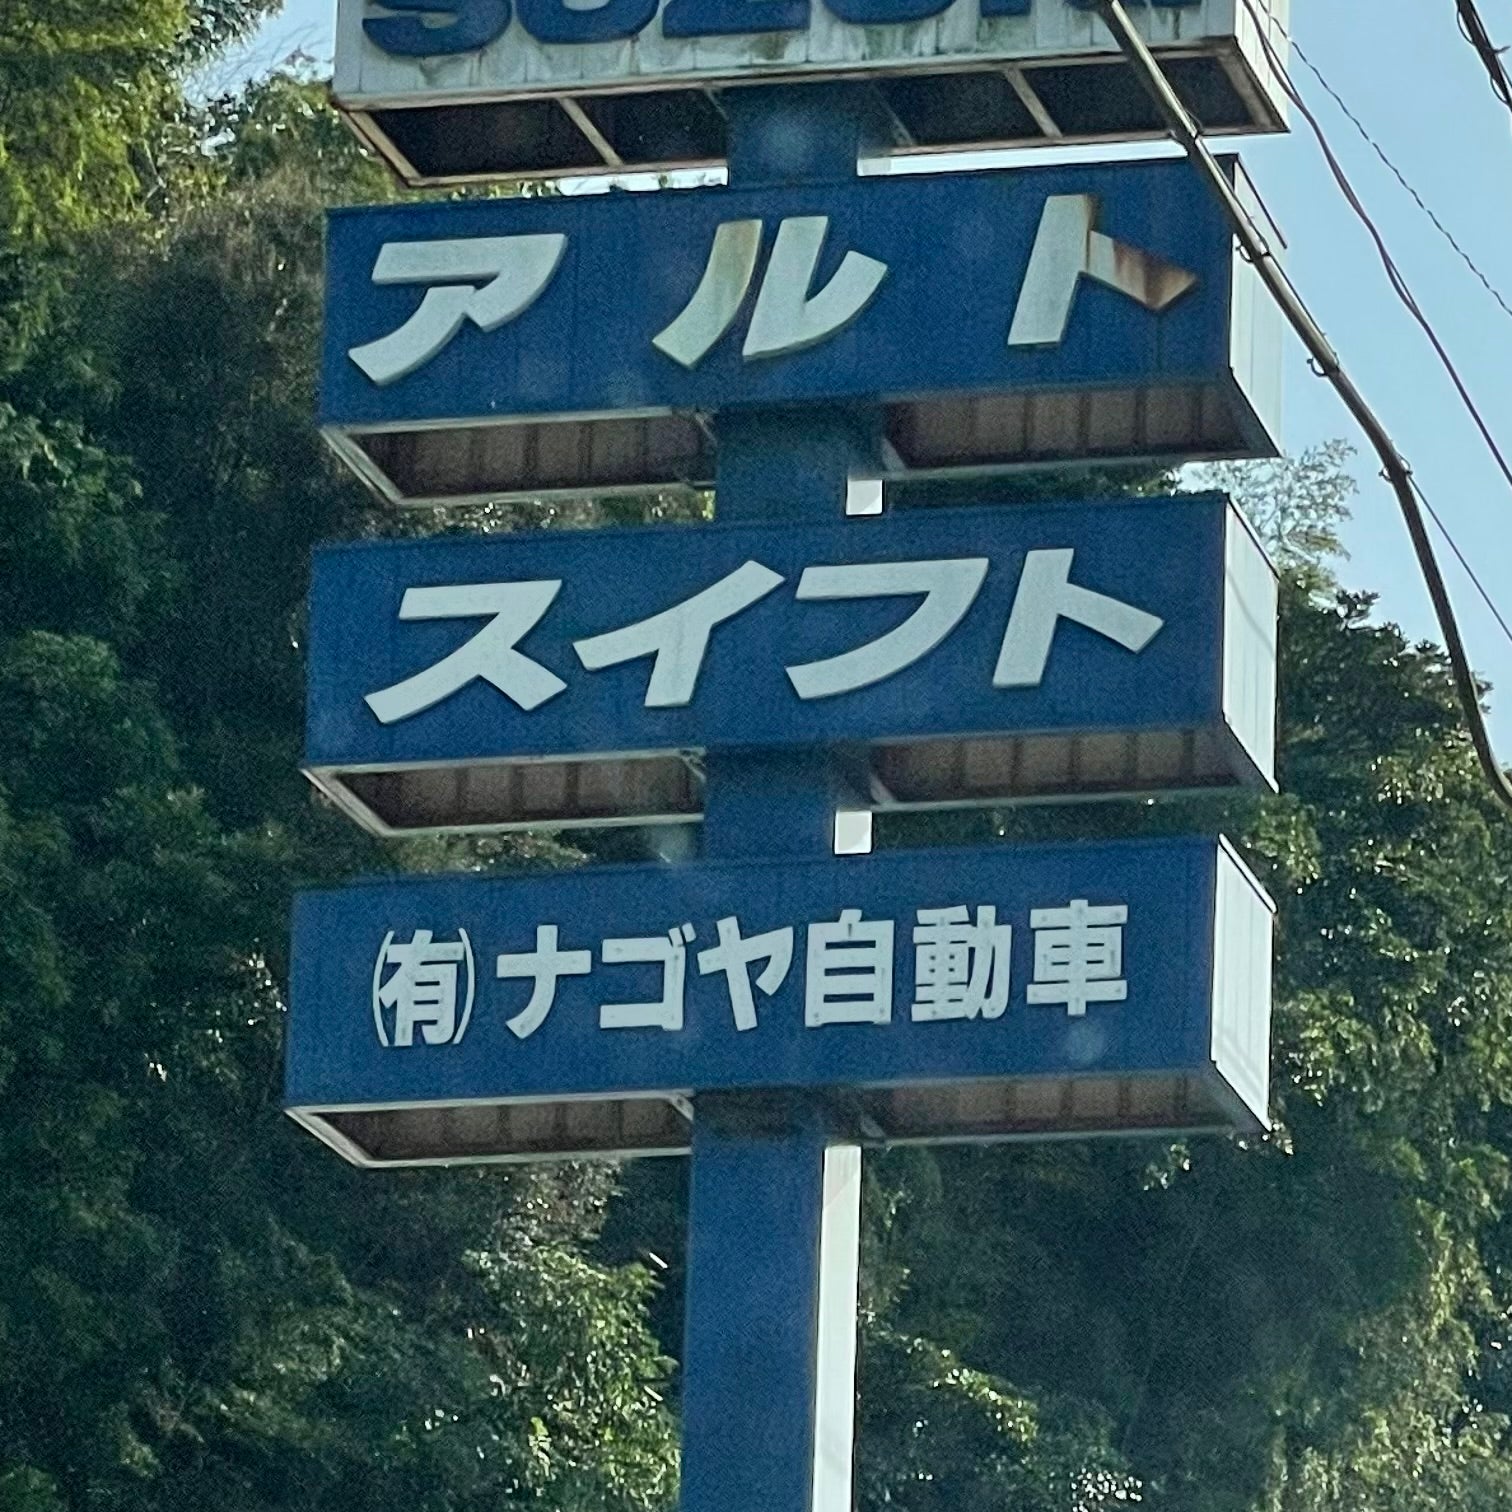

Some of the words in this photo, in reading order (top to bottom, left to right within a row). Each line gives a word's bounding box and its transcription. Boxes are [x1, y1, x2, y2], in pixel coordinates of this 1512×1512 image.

[348, 193, 1199, 385] アルト
[363, 547, 1165, 725] スイフト
